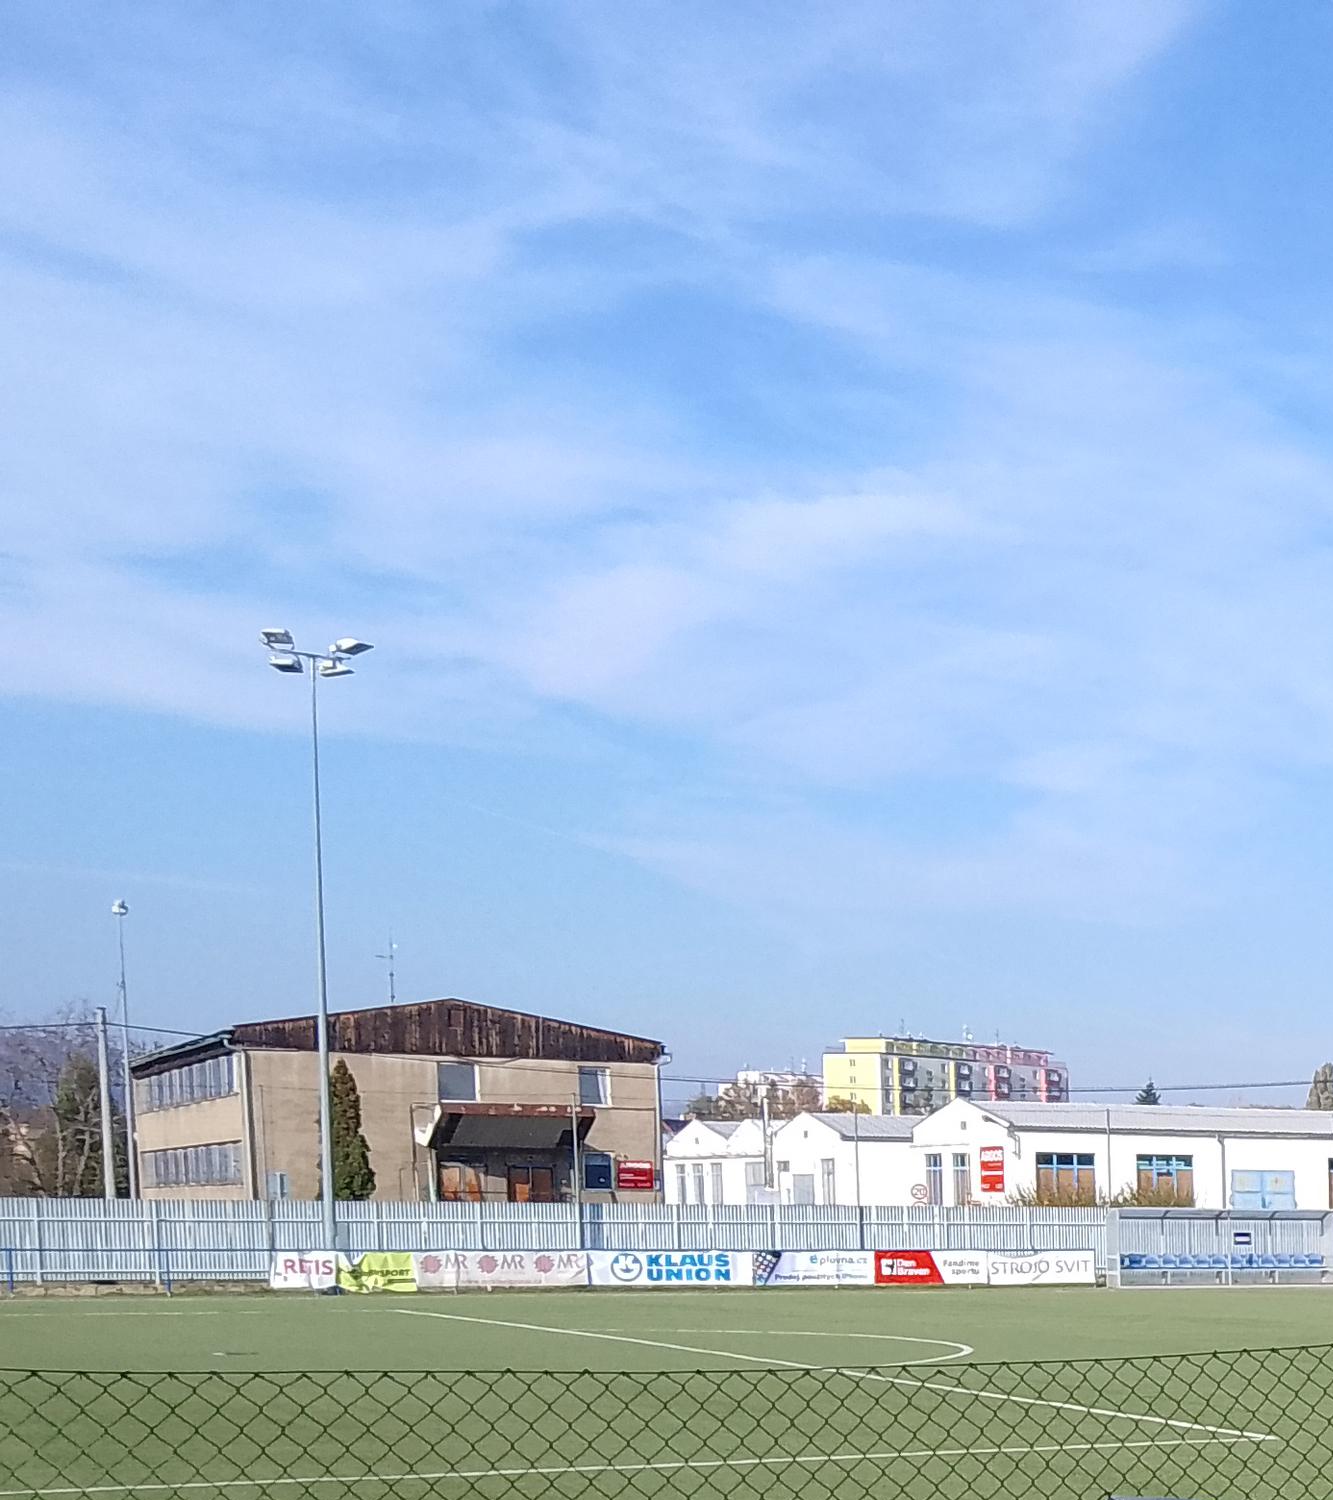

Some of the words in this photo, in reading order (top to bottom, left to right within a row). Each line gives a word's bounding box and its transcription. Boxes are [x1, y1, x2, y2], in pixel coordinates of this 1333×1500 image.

[500, 1254, 525, 1269] MR
[646, 1253, 730, 1267] KLAUS
[1056, 1260, 1091, 1274] SVIT
[646, 1268, 731, 1281] UNION
